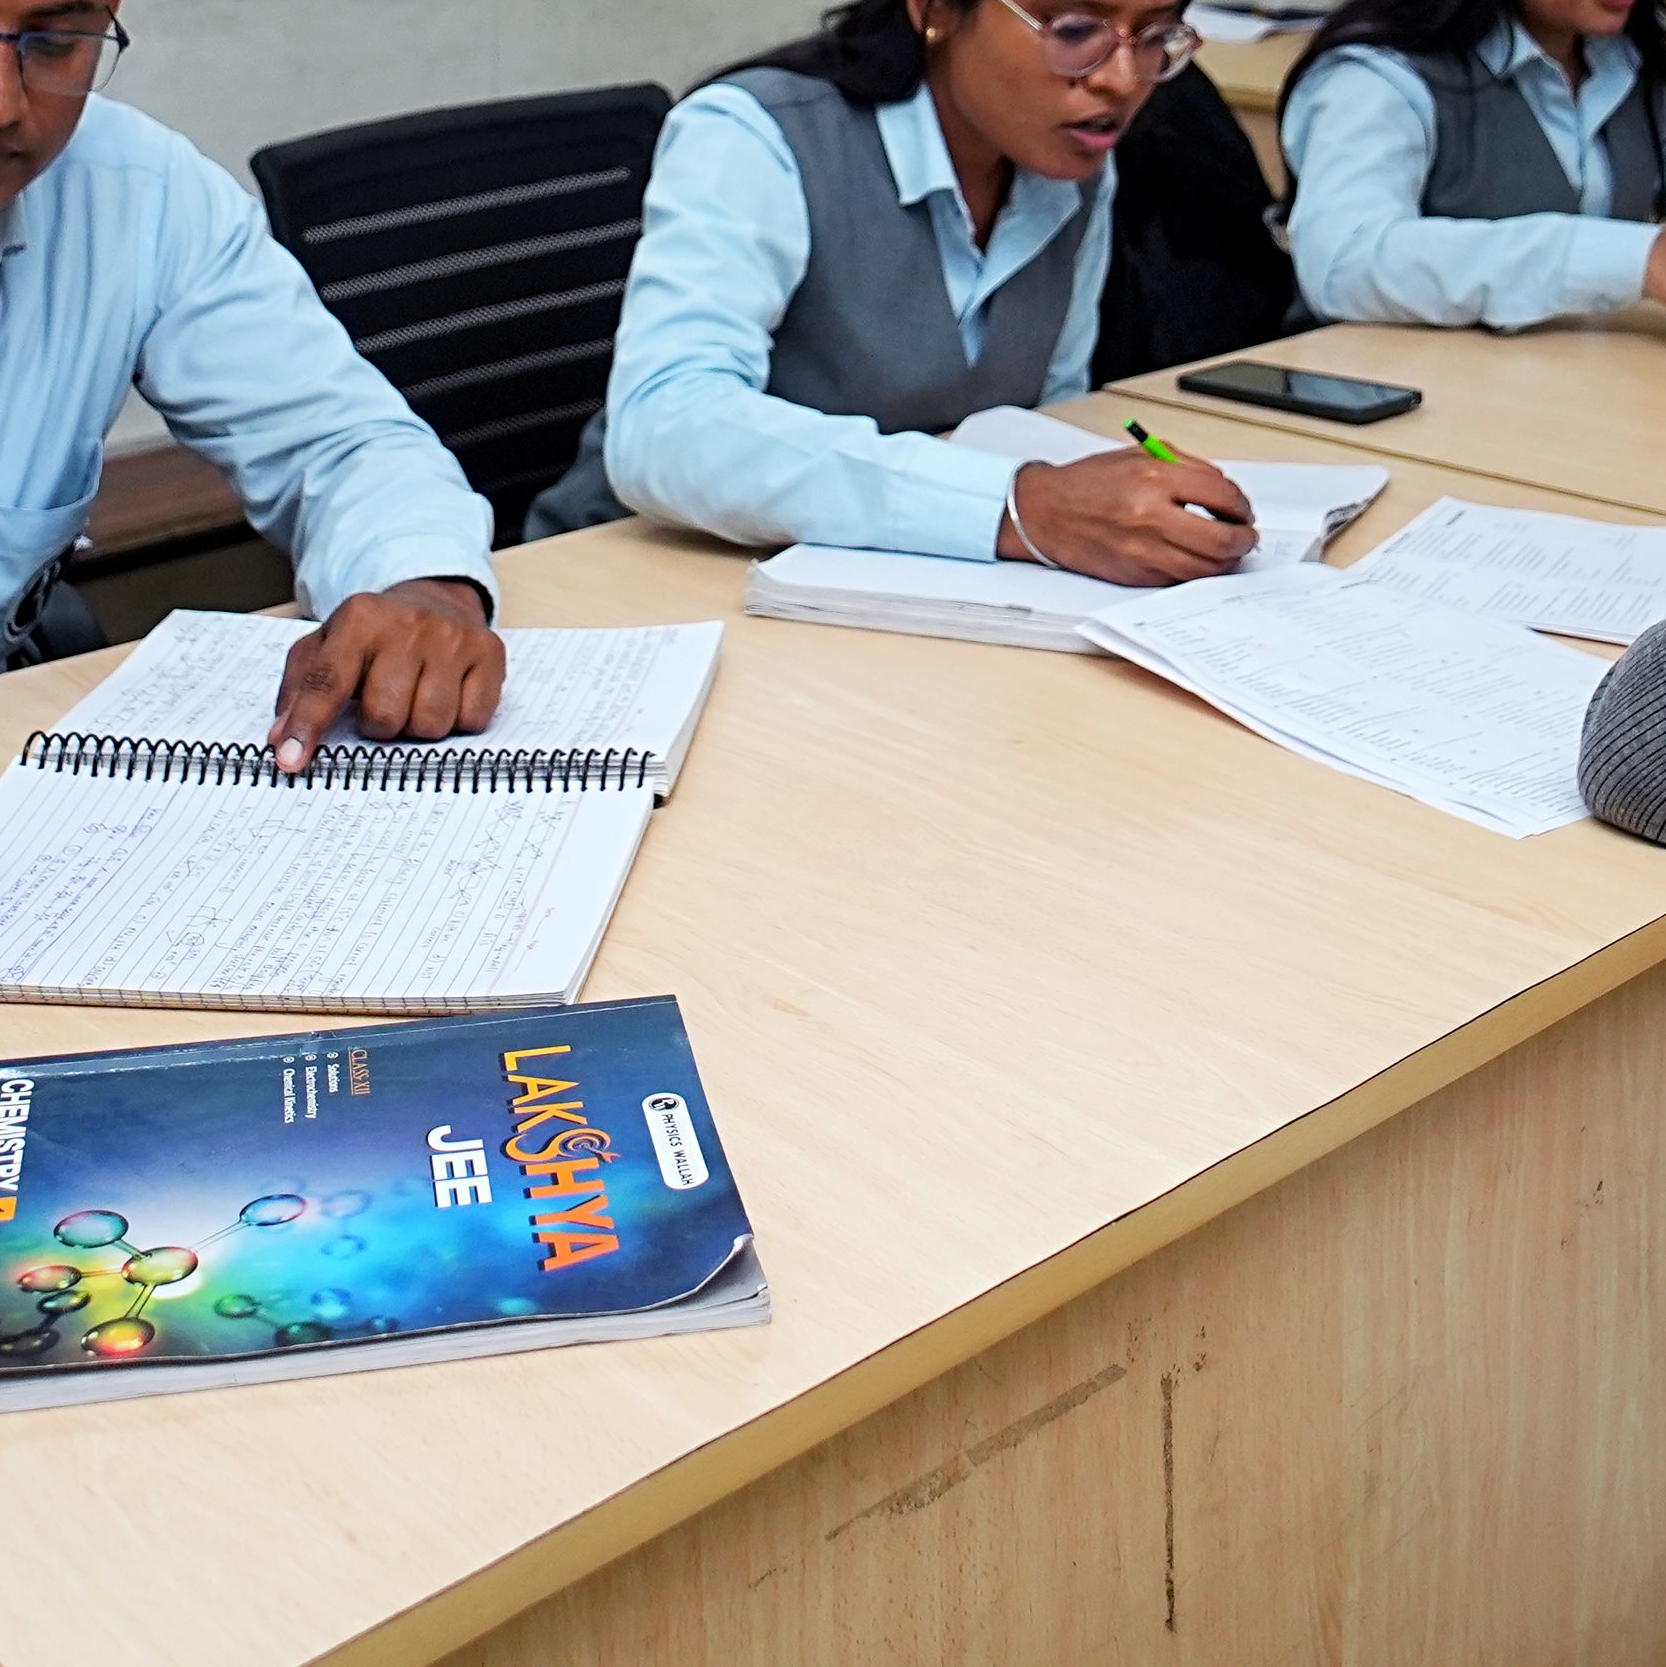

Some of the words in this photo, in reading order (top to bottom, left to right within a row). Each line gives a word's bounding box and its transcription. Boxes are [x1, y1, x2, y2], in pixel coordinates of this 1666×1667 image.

[283, 1068, 296, 1096] Chemical
[305, 1066, 319, 1119] Electrochemistry
[327, 1063, 340, 1093] Solutions
[284, 1097, 297, 1124] Kinetics
[427, 1124, 493, 1209] JEE
[503, 1045, 621, 1272] LAKSHYA
[661, 1114, 683, 1148] PHYSICS
[672, 1150, 696, 1186] WALLAH
